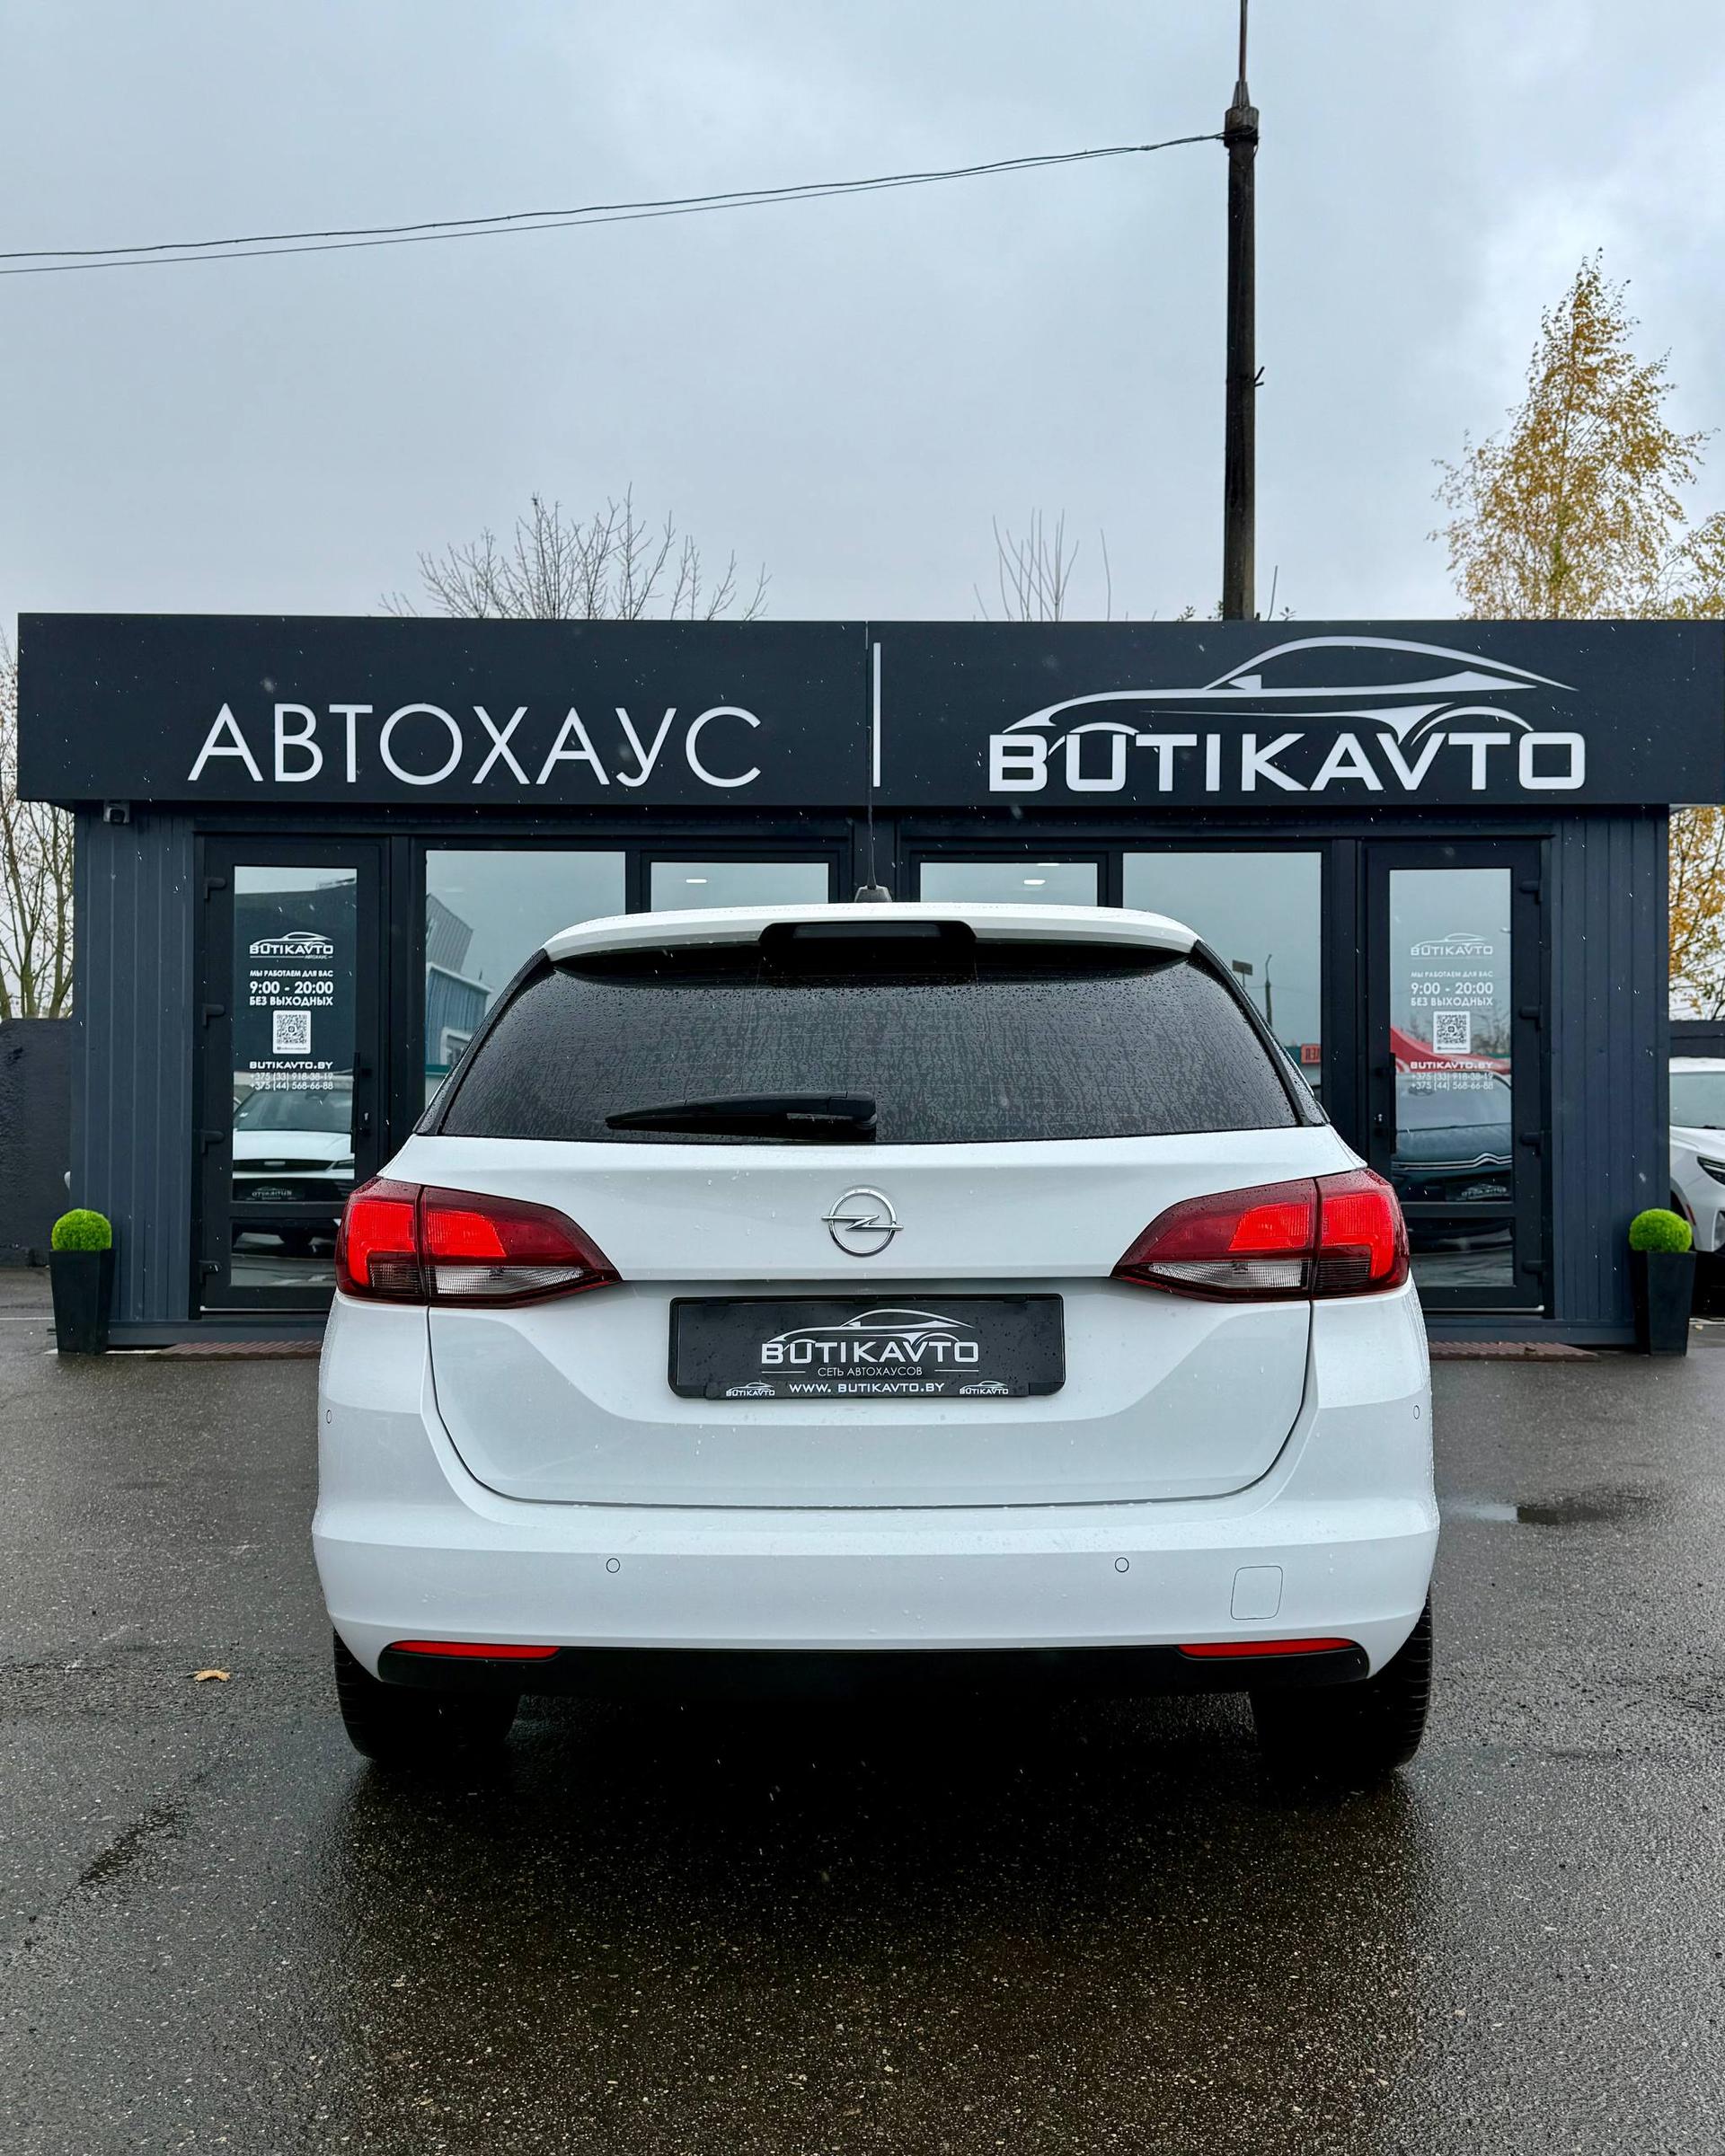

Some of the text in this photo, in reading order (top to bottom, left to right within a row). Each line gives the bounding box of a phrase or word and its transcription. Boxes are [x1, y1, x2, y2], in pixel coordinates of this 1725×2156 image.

[187, 702, 761, 787] АВТОХАУС
[989, 732, 1586, 791] BUTIKAVTO
[249, 944, 333, 955] BUTIKAVTO
[1411, 945, 1493, 956] BUTIKAVTO
[250, 981, 280, 994] 9:00
[294, 981, 333, 994] 20:00
[1411, 982, 1440, 994] 9:00
[1455, 982, 1493, 994] 20:00
[249, 996, 333, 1006] БЕЗ ВЫХОДНЫХ
[1411, 997, 1493, 1007] БЕЗ ВЫХОДНЫХ
[249, 1061, 333, 1069] BUTIKAVTO.BY
[1410, 1061, 1493, 1069] BUTIKAVTO.BY
[251, 1073, 270, 1081] +375
[273, 1072, 288, 1082] (33)
[250, 1081, 333, 1091] +375 (44) 568-66-88
[1411, 1082, 1431, 1090] +375
[762, 1342, 979, 1364] BUTIKAVTO
[818, 1366, 923, 1377] СЕТЬ АВТОХАУСОВ
[789, 1383, 945, 1392] WWW. BUTIKAVTO.BY
